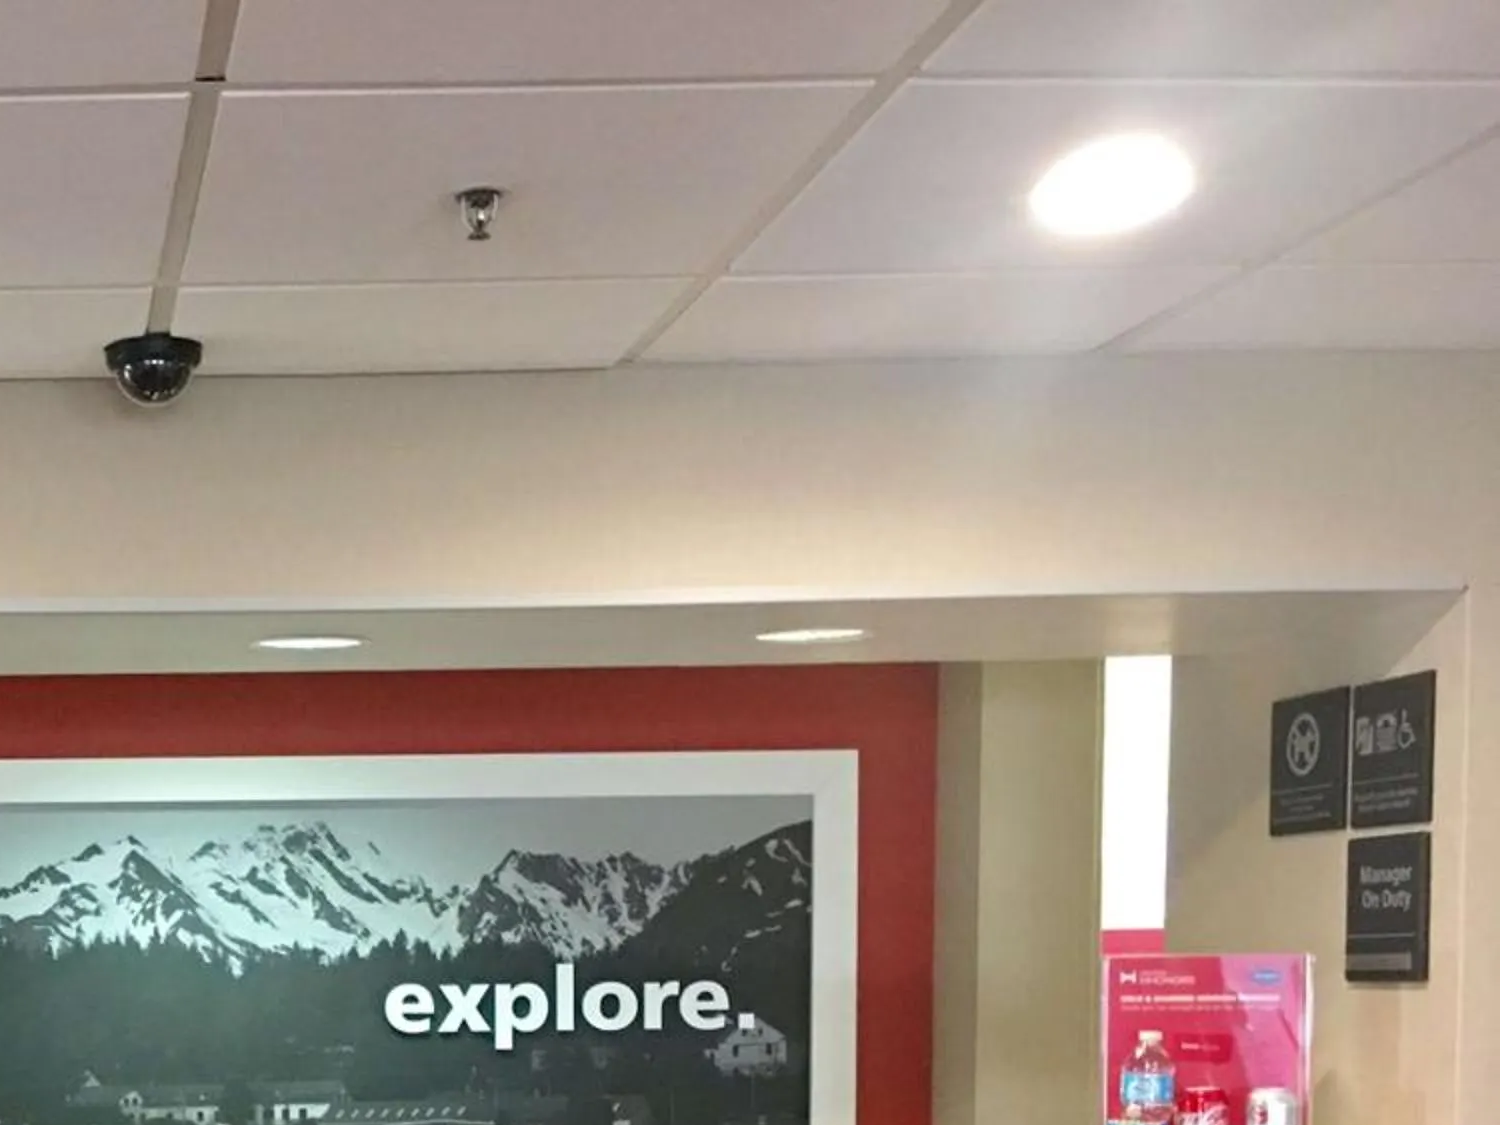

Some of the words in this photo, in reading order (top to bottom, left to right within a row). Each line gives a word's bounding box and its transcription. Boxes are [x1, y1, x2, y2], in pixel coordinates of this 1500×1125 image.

[1360, 865, 1413, 887] Manager
[1361, 889, 1380, 909] On
[1382, 888, 1412, 912] Duty
[384, 963, 755, 1051] explore.
